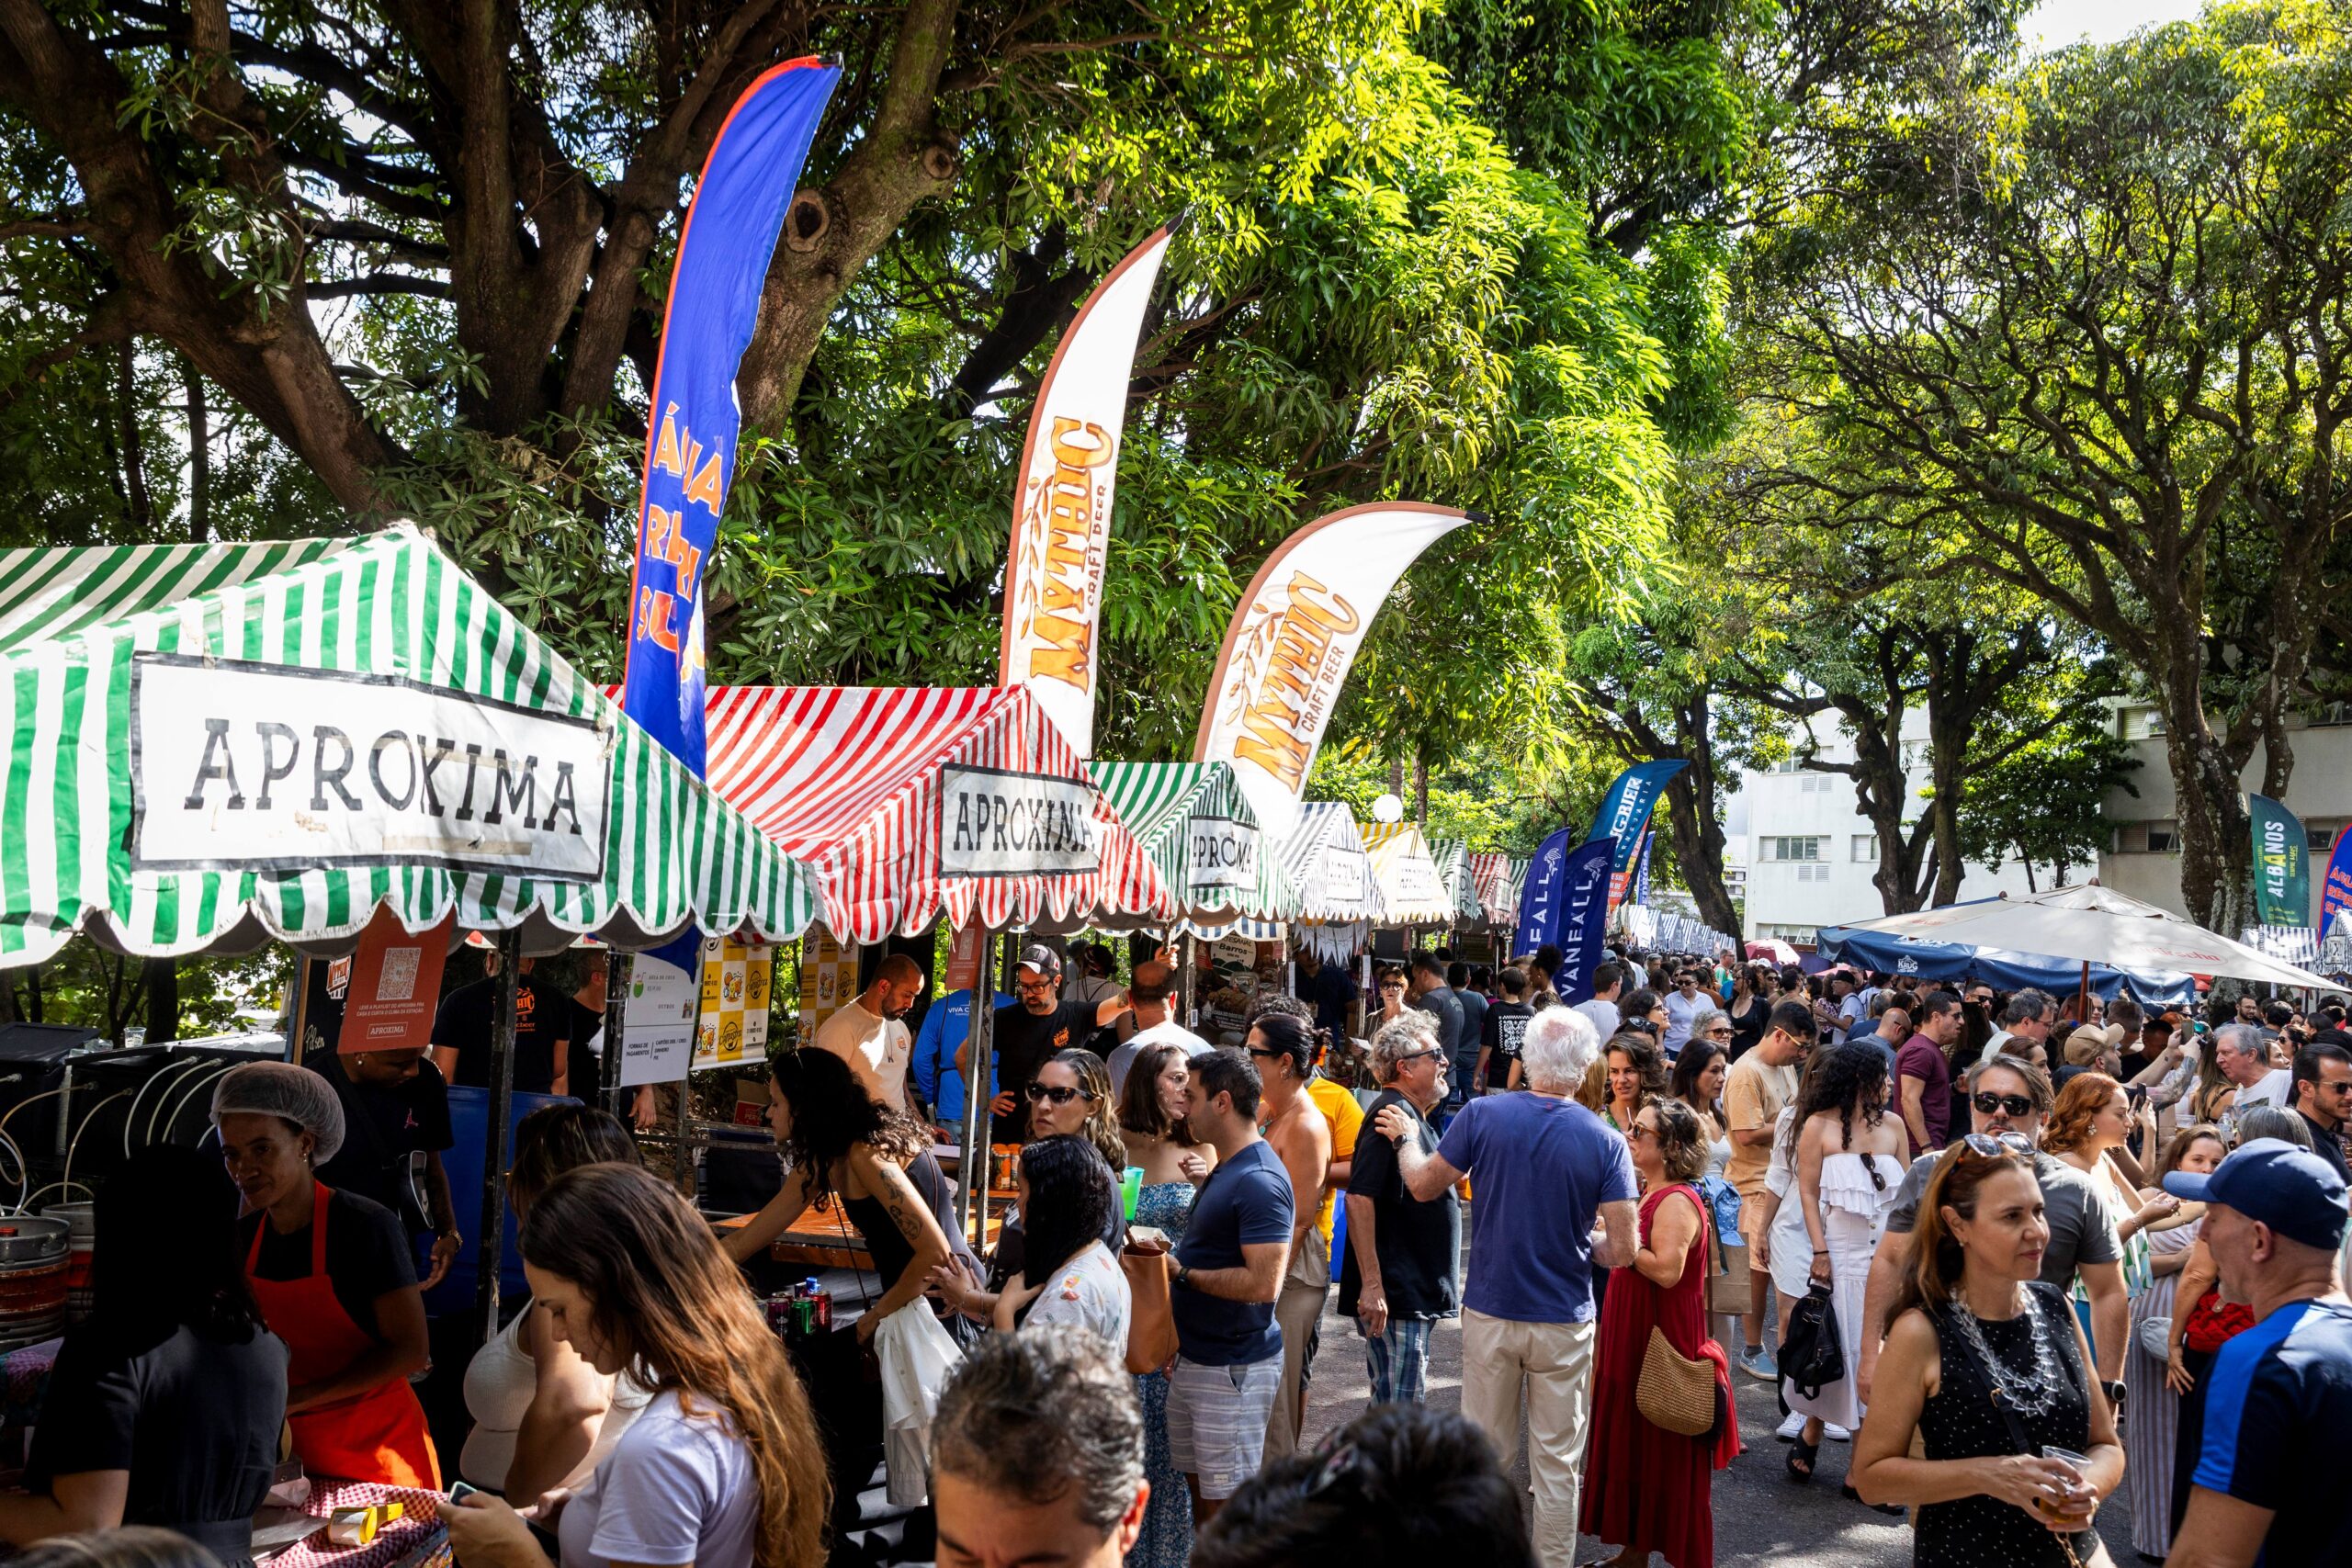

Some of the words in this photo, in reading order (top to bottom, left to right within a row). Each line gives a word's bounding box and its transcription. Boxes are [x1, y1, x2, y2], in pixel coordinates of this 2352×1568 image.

[1031, 416, 1114, 696] MYTHIC
[1087, 543, 1102, 607] CRAFT
[1234, 570, 1360, 795] MYTHIC
[1301, 685, 1329, 733] CRAFT
[1322, 646, 1345, 685] BEER
[184, 718, 582, 835] APROXIMA
[954, 792, 1095, 852] APROXIMA
[2264, 820, 2286, 898] ALBANOS
[1219, 943, 1248, 954] Barros
[1528, 874, 1550, 954] FALL
[370, 1026, 404, 1034] APROXIMA
